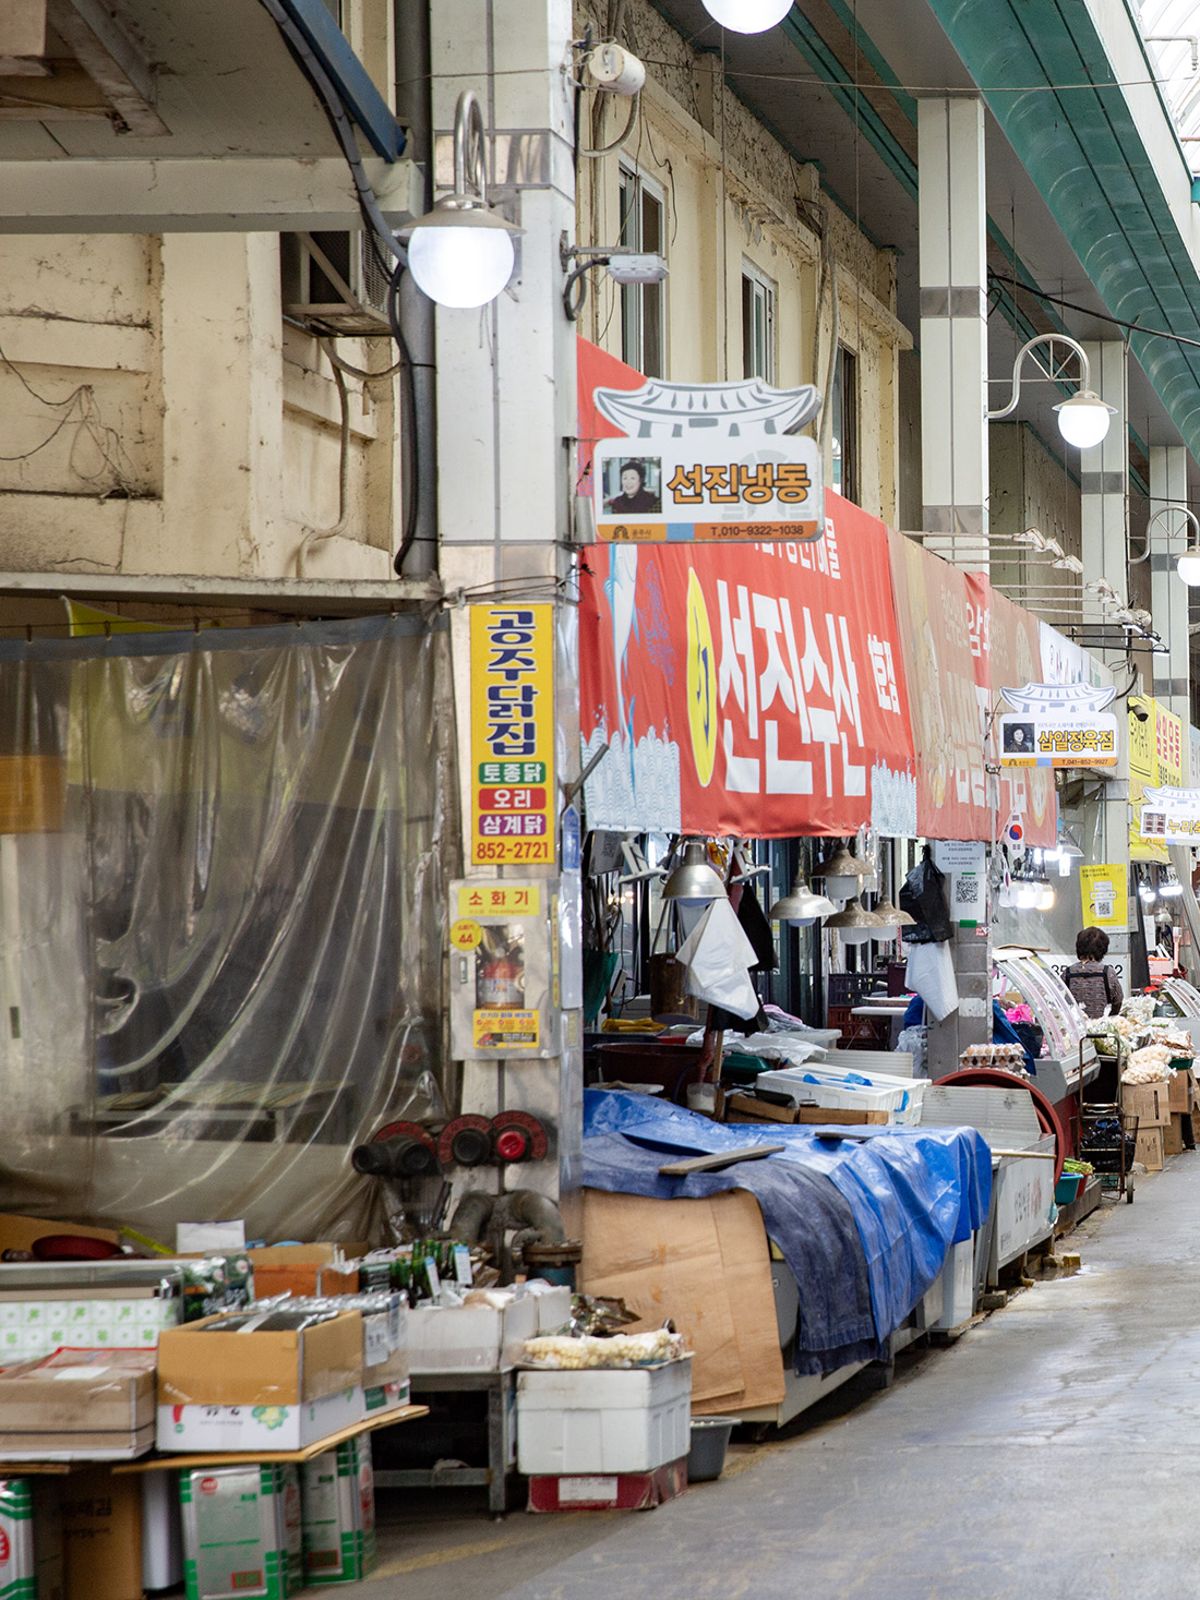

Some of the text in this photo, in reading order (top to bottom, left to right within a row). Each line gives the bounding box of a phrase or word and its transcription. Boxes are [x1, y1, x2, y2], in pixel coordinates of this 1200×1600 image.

[667, 463, 811, 505] 선진냉동
[486, 611, 538, 756] 공주닭집
[716, 579, 866, 797] 선진수산
[1037, 730, 1114, 752] 삼일정육점
[483, 762, 542, 782] 토종닭
[494, 789, 531, 809] 오리
[483, 814, 543, 835] 삼계닭
[476, 842, 548, 860] 852-2721
[469, 891, 529, 906] 소화기
